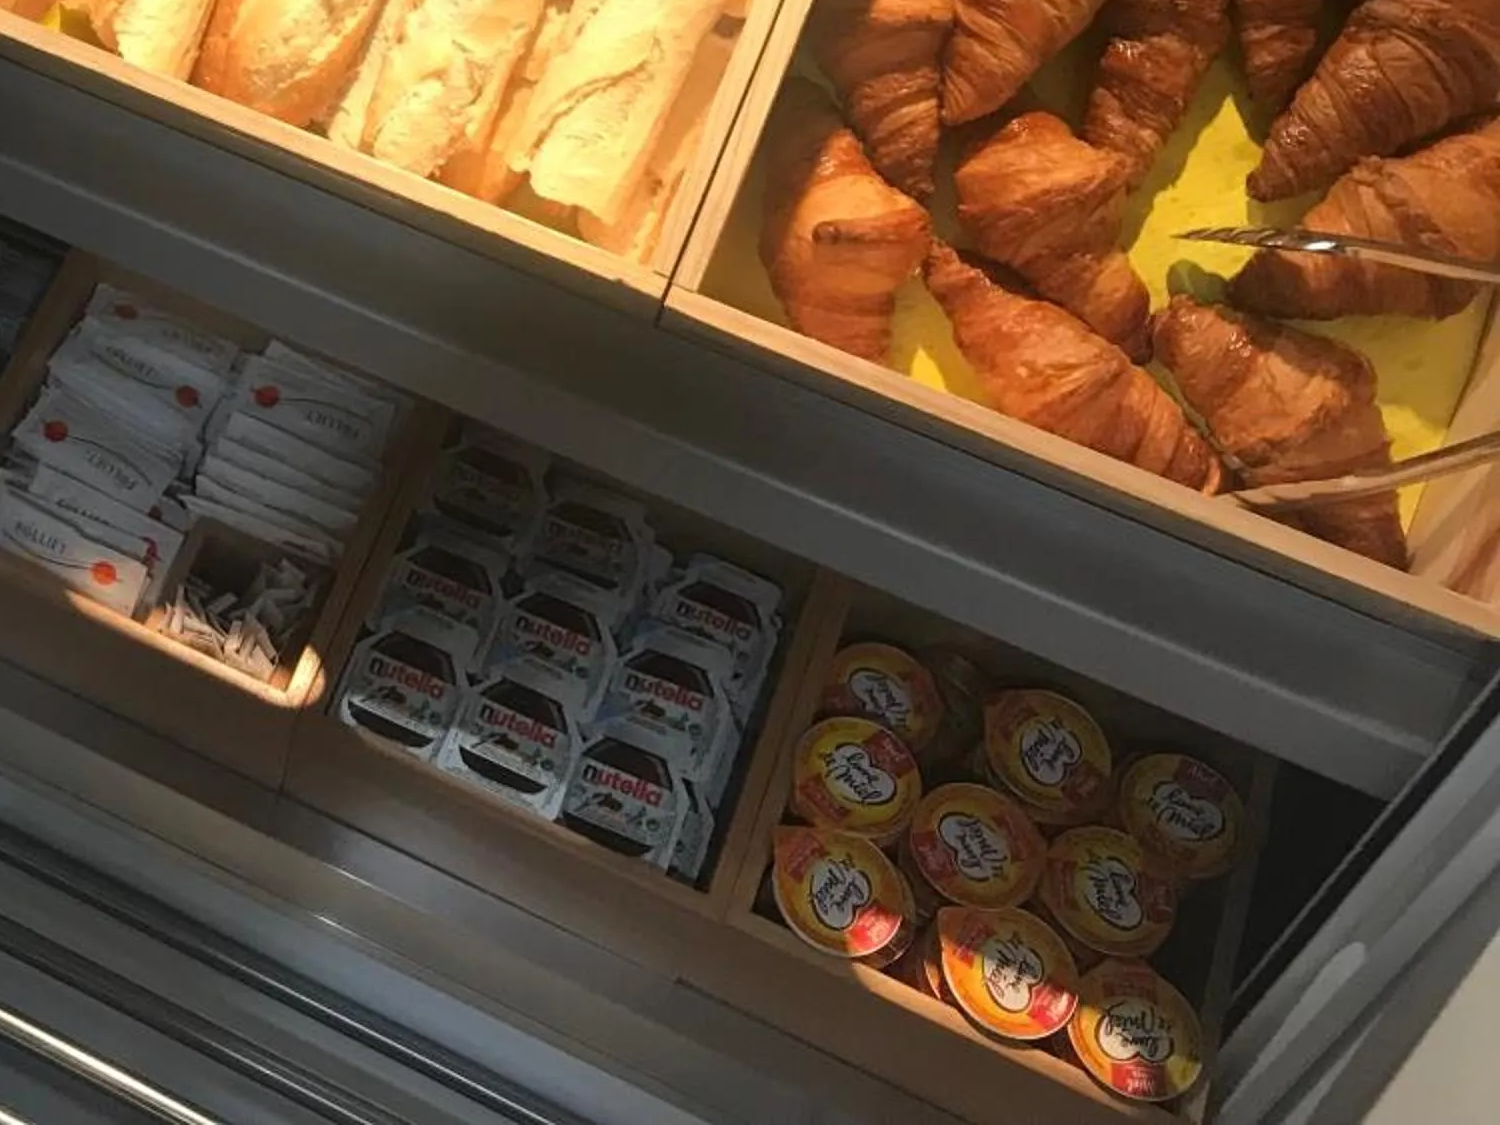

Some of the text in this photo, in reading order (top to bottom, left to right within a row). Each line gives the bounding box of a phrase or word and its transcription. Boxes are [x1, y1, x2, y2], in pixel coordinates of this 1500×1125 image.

[406, 572, 481, 610] nutella
[516, 615, 591, 657] nutella
[677, 601, 752, 641] nutella
[370, 656, 445, 701] nutella
[625, 674, 702, 712] nutella
[480, 702, 558, 748] nutella
[584, 764, 664, 807] nutella
